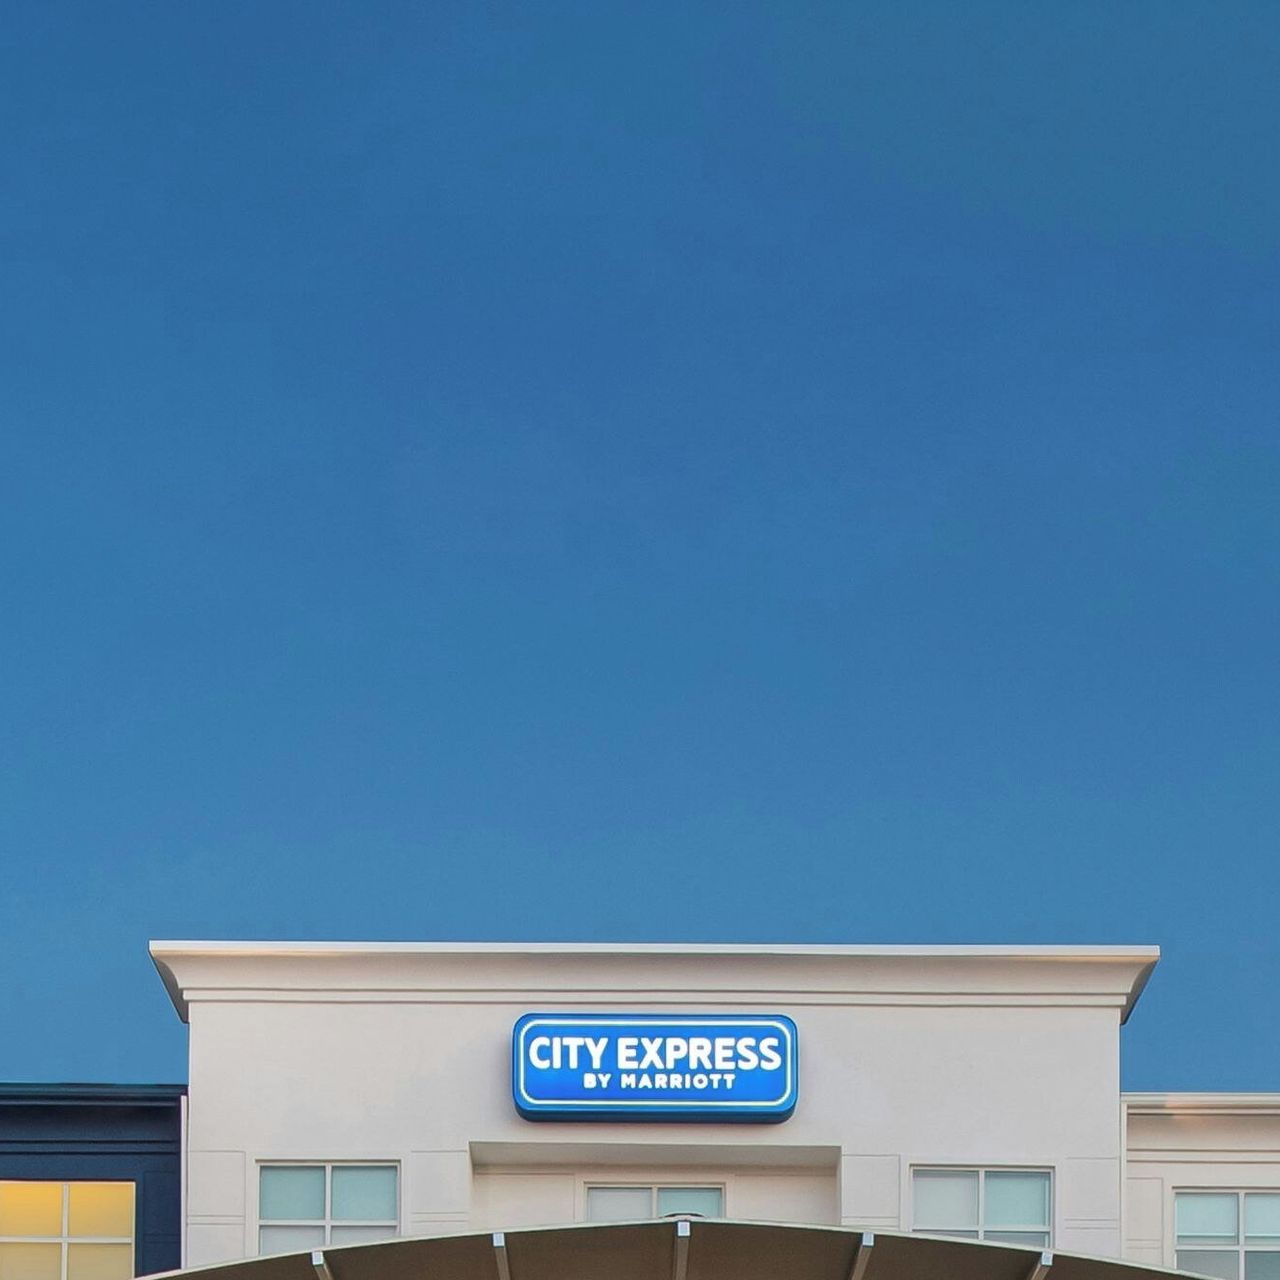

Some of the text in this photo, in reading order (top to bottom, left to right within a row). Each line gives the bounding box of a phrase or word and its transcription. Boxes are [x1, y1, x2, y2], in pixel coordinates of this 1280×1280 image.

[529, 1037, 782, 1070] CITY EXPRESS
[583, 1073, 736, 1089] BY MARRIOTT
